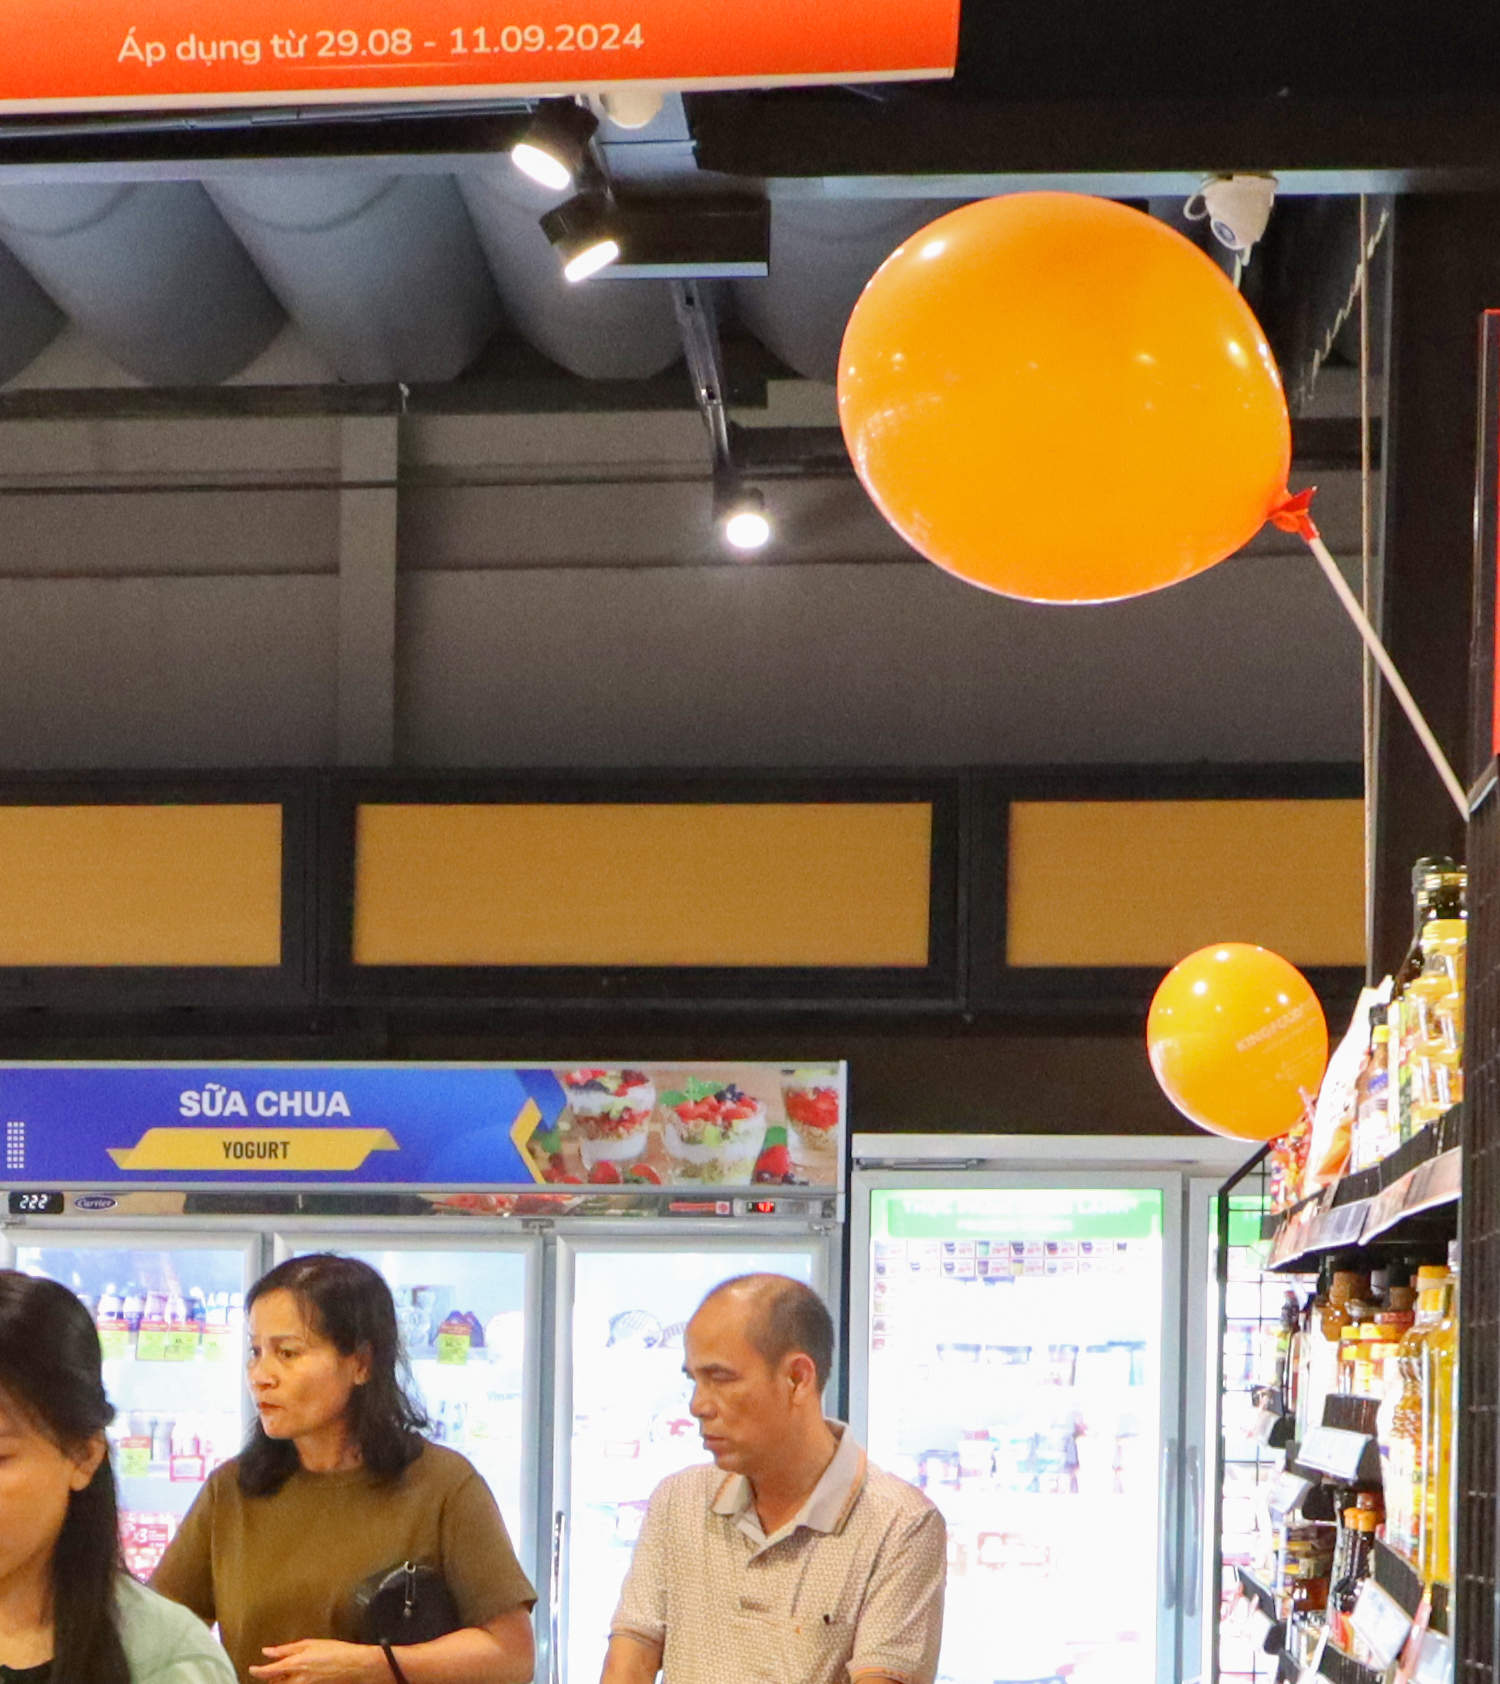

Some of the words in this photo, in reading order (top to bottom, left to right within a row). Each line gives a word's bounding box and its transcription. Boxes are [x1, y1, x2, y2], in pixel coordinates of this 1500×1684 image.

[117, 26, 166, 67] Áp
[175, 33, 262, 68] dụng
[270, 30, 308, 61] từ
[315, 29, 413, 58] 29.08
[449, 23, 645, 56] 11.09.2024
[179, 1084, 249, 1118] SỮA
[255, 1090, 351, 1118] CHUA
[222, 1141, 290, 1160] YOGURT
